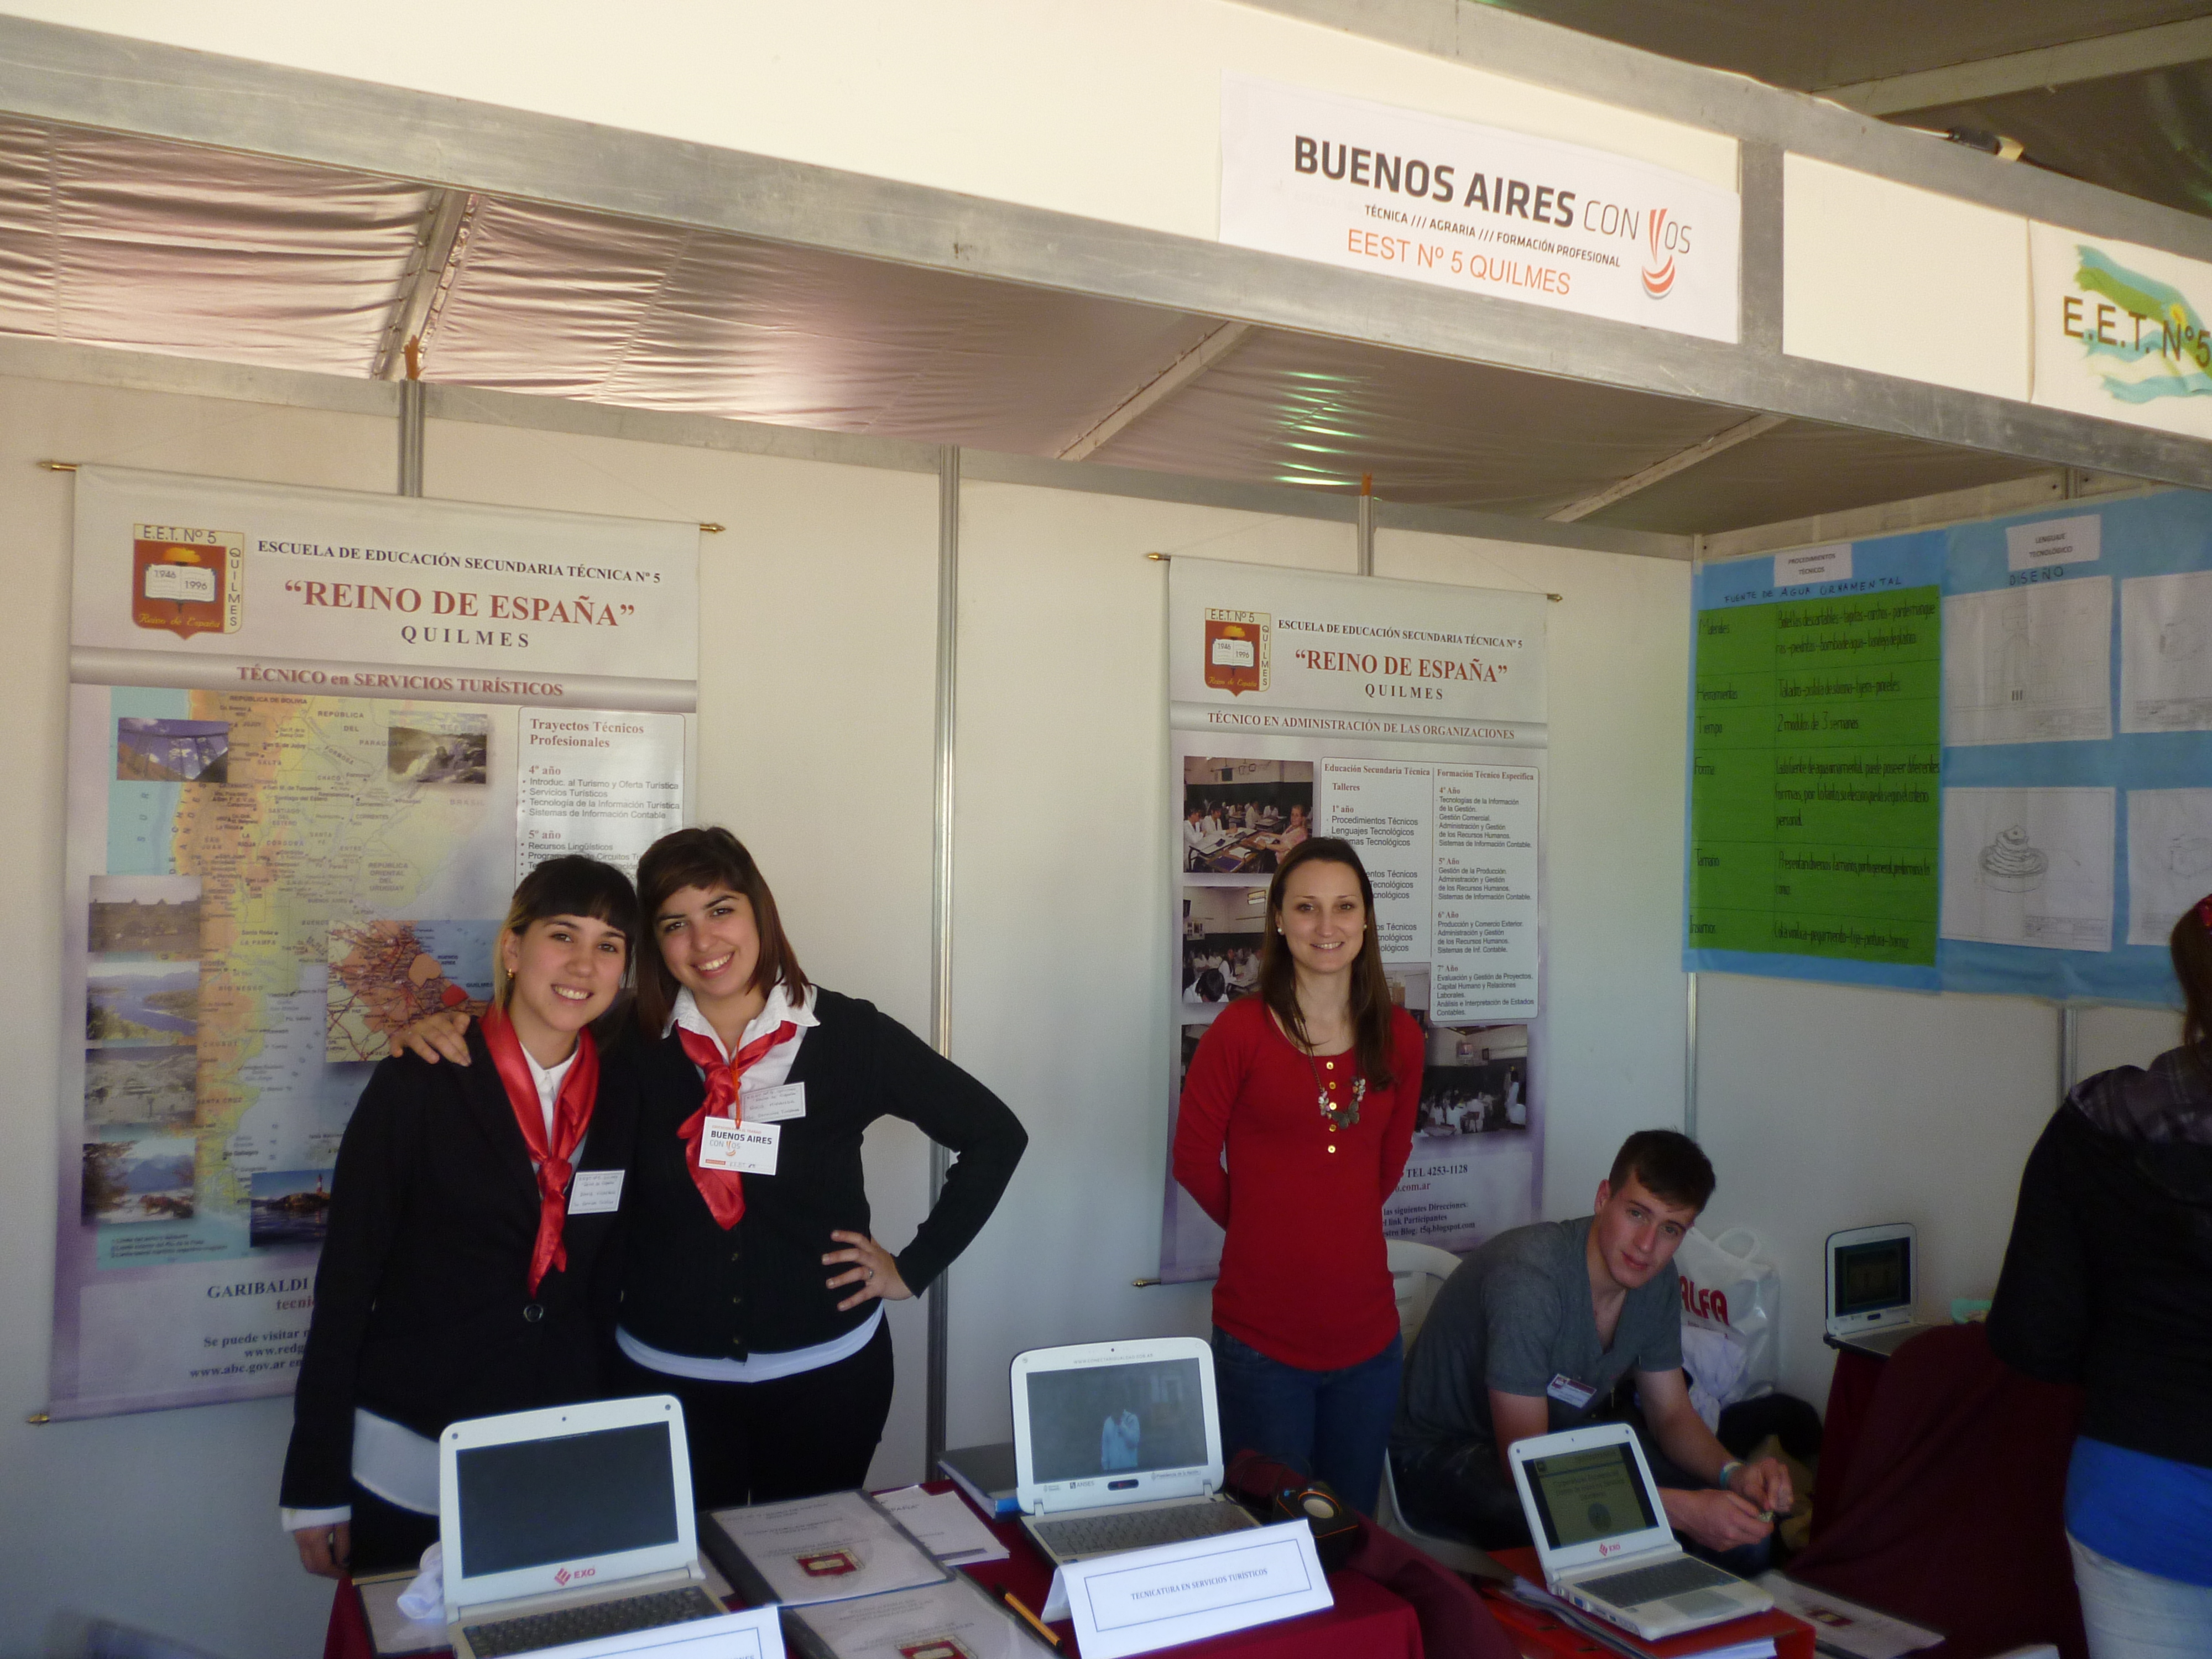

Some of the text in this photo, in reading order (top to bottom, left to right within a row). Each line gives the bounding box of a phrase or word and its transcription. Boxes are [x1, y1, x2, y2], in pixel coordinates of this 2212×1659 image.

[1295, 134, 1455, 204] BUENOS
[1463, 172, 1576, 228] AIRES
[1583, 200, 1640, 240] CON
[1365, 204, 1621, 267] TÉCNICA AGRARIA FORMACIÓN PROFESIONAL
[1348, 228, 1411, 262] EEST
[1451, 250, 1462, 273] 5
[1470, 254, 1571, 295] QUILMES
[143, 525, 178, 541] E.E.T.
[207, 531, 216, 544] 5
[2036, 533, 2065, 544] LENGUAJE
[258, 540, 335, 558] ESCUELA
[339, 547, 361, 559] DE
[365, 549, 460, 567] EDUCACIÓN
[465, 557, 564, 576] SECUNDARIA
[567, 564, 632, 581] TÉCNICA
[653, 573, 660, 583] 5
[1788, 553, 1835, 565] PROCEDIMIENTOS
[154, 570, 176, 578] 1946
[1798, 567, 1825, 575] TÉCNICOS
[185, 581, 207, 590] 1996
[1724, 591, 1756, 603] FUENTE
[1781, 587, 1811, 596] AGUA
[431, 590, 478, 617] DE
[1211, 609, 1232, 621] E.E.T.
[1249, 612, 1255, 623] 5
[401, 625, 529, 648] QUILMES
[1278, 619, 1324, 632] ESCUELA
[1327, 624, 1340, 633] DE
[1343, 625, 1400, 639] EDUCACIÓN
[1402, 630, 1463, 644] SECUNDARIA
[1465, 634, 1505, 648] TÉCNICA
[1518, 640, 1522, 649] 5
[1384, 656, 1412, 676] DE
[237, 664, 564, 696] TÉCNICO en SERVICIOS TURÍSTICOS
[1365, 684, 1443, 700] QUILMES
[530, 718, 644, 734] Trayectos Técnicos
[1207, 711, 1515, 739] TÉCNICO EN ADMINISTRACIÓN DE LAS ORGANIZACIONES
[530, 734, 610, 748] Profesionales
[542, 766, 561, 775] año
[1324, 764, 1430, 775] Educación Secundaria Técnica
[1437, 769, 1473, 778] Formación
[530, 778, 565, 786] Introduc.
[578, 779, 609, 787] Turismo
[1333, 782, 1360, 791] Talleres
[529, 808, 567, 817] Sistemas
[582, 810, 629, 818] Información
[1332, 816, 1418, 826] Procedimientos Técnicos
[542, 831, 561, 839] año
[1332, 826, 1414, 837] Lenguajes Tecnológicos
[1366, 838, 1410, 847] Tecnológicos
[1387, 870, 1418, 878] Técnicos
[711, 1130, 772, 1145] BUENOS AIRES
[1406, 1165, 1468, 1178] TEL 4253-1128
[1394, 1206, 1426, 1215] siguientes
[1404, 1214, 1447, 1224] Participantes
[207, 1277, 308, 1299] GARIBALDI
[204, 1330, 300, 1348] Se puede visitar
[574, 1568, 596, 1578] EXO
[1131, 1585, 1180, 1600] TECNICATURA
[1192, 1576, 1227, 1589] SERVICIOS
